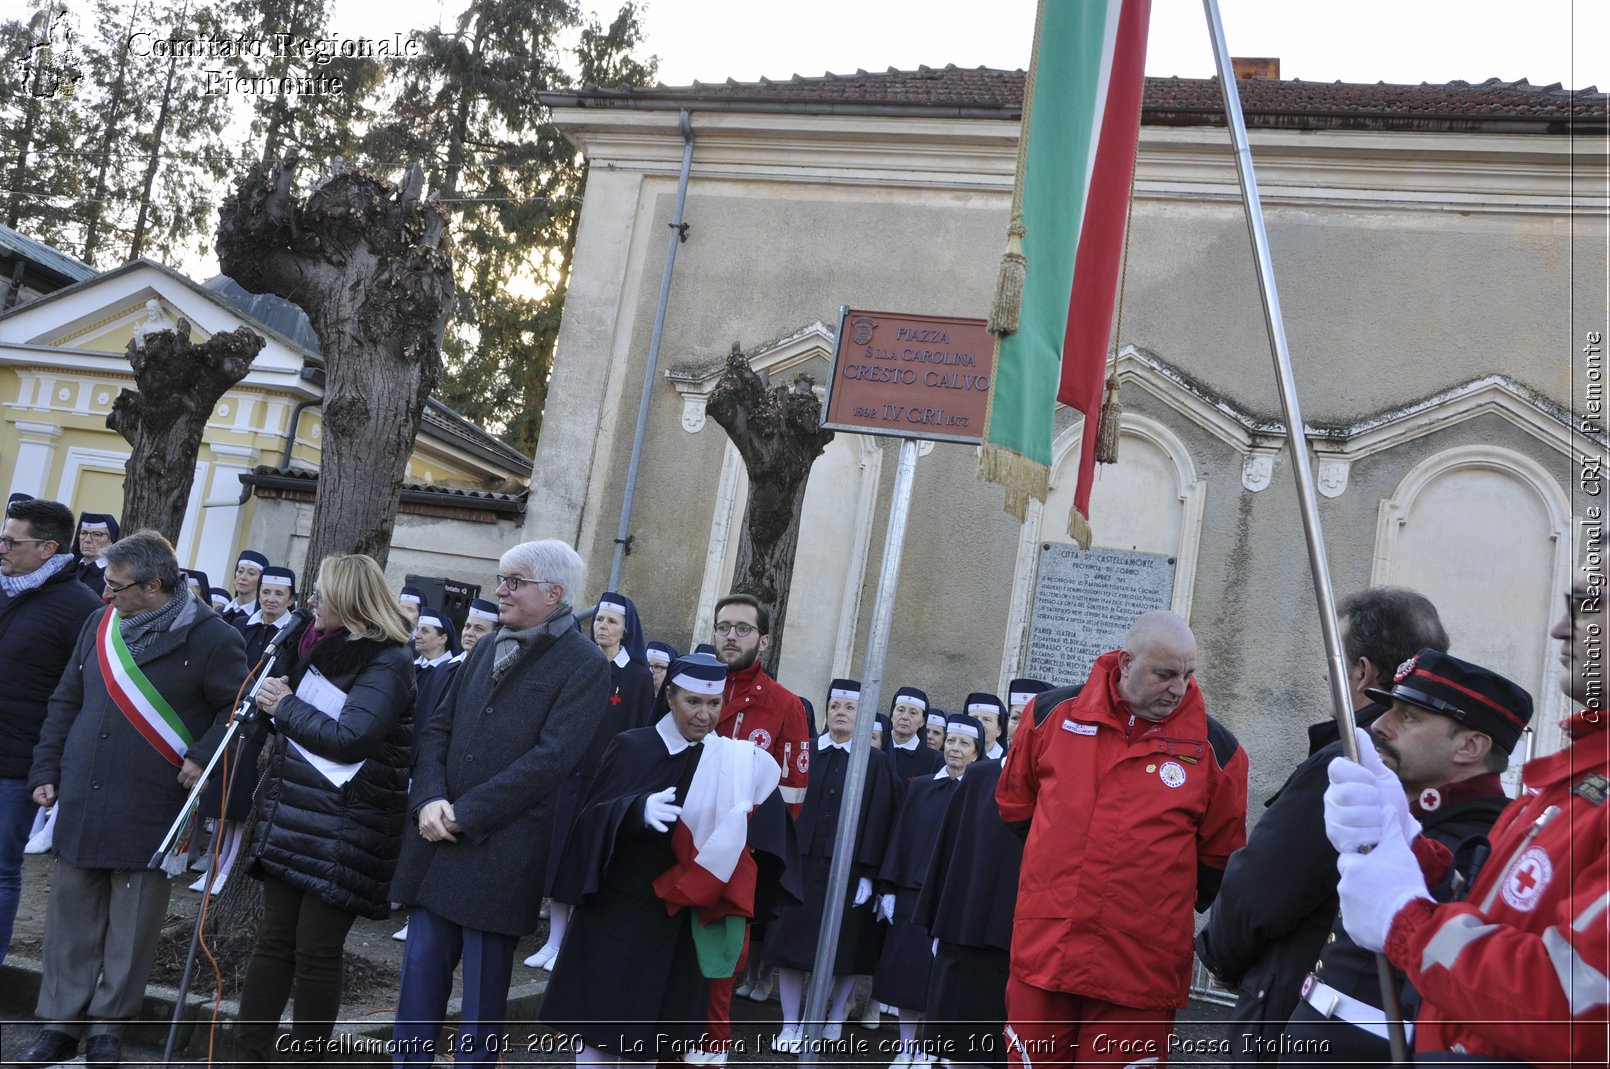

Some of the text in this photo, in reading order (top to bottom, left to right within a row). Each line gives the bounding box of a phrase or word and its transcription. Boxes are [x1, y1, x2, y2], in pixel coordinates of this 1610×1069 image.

[896, 327, 951, 344] PIAZZA
[900, 349, 977, 367] CAROLINA
[843, 364, 991, 392] CRESTO CALVO
[1096, 554, 1153, 568] CASTELLAMONTE
